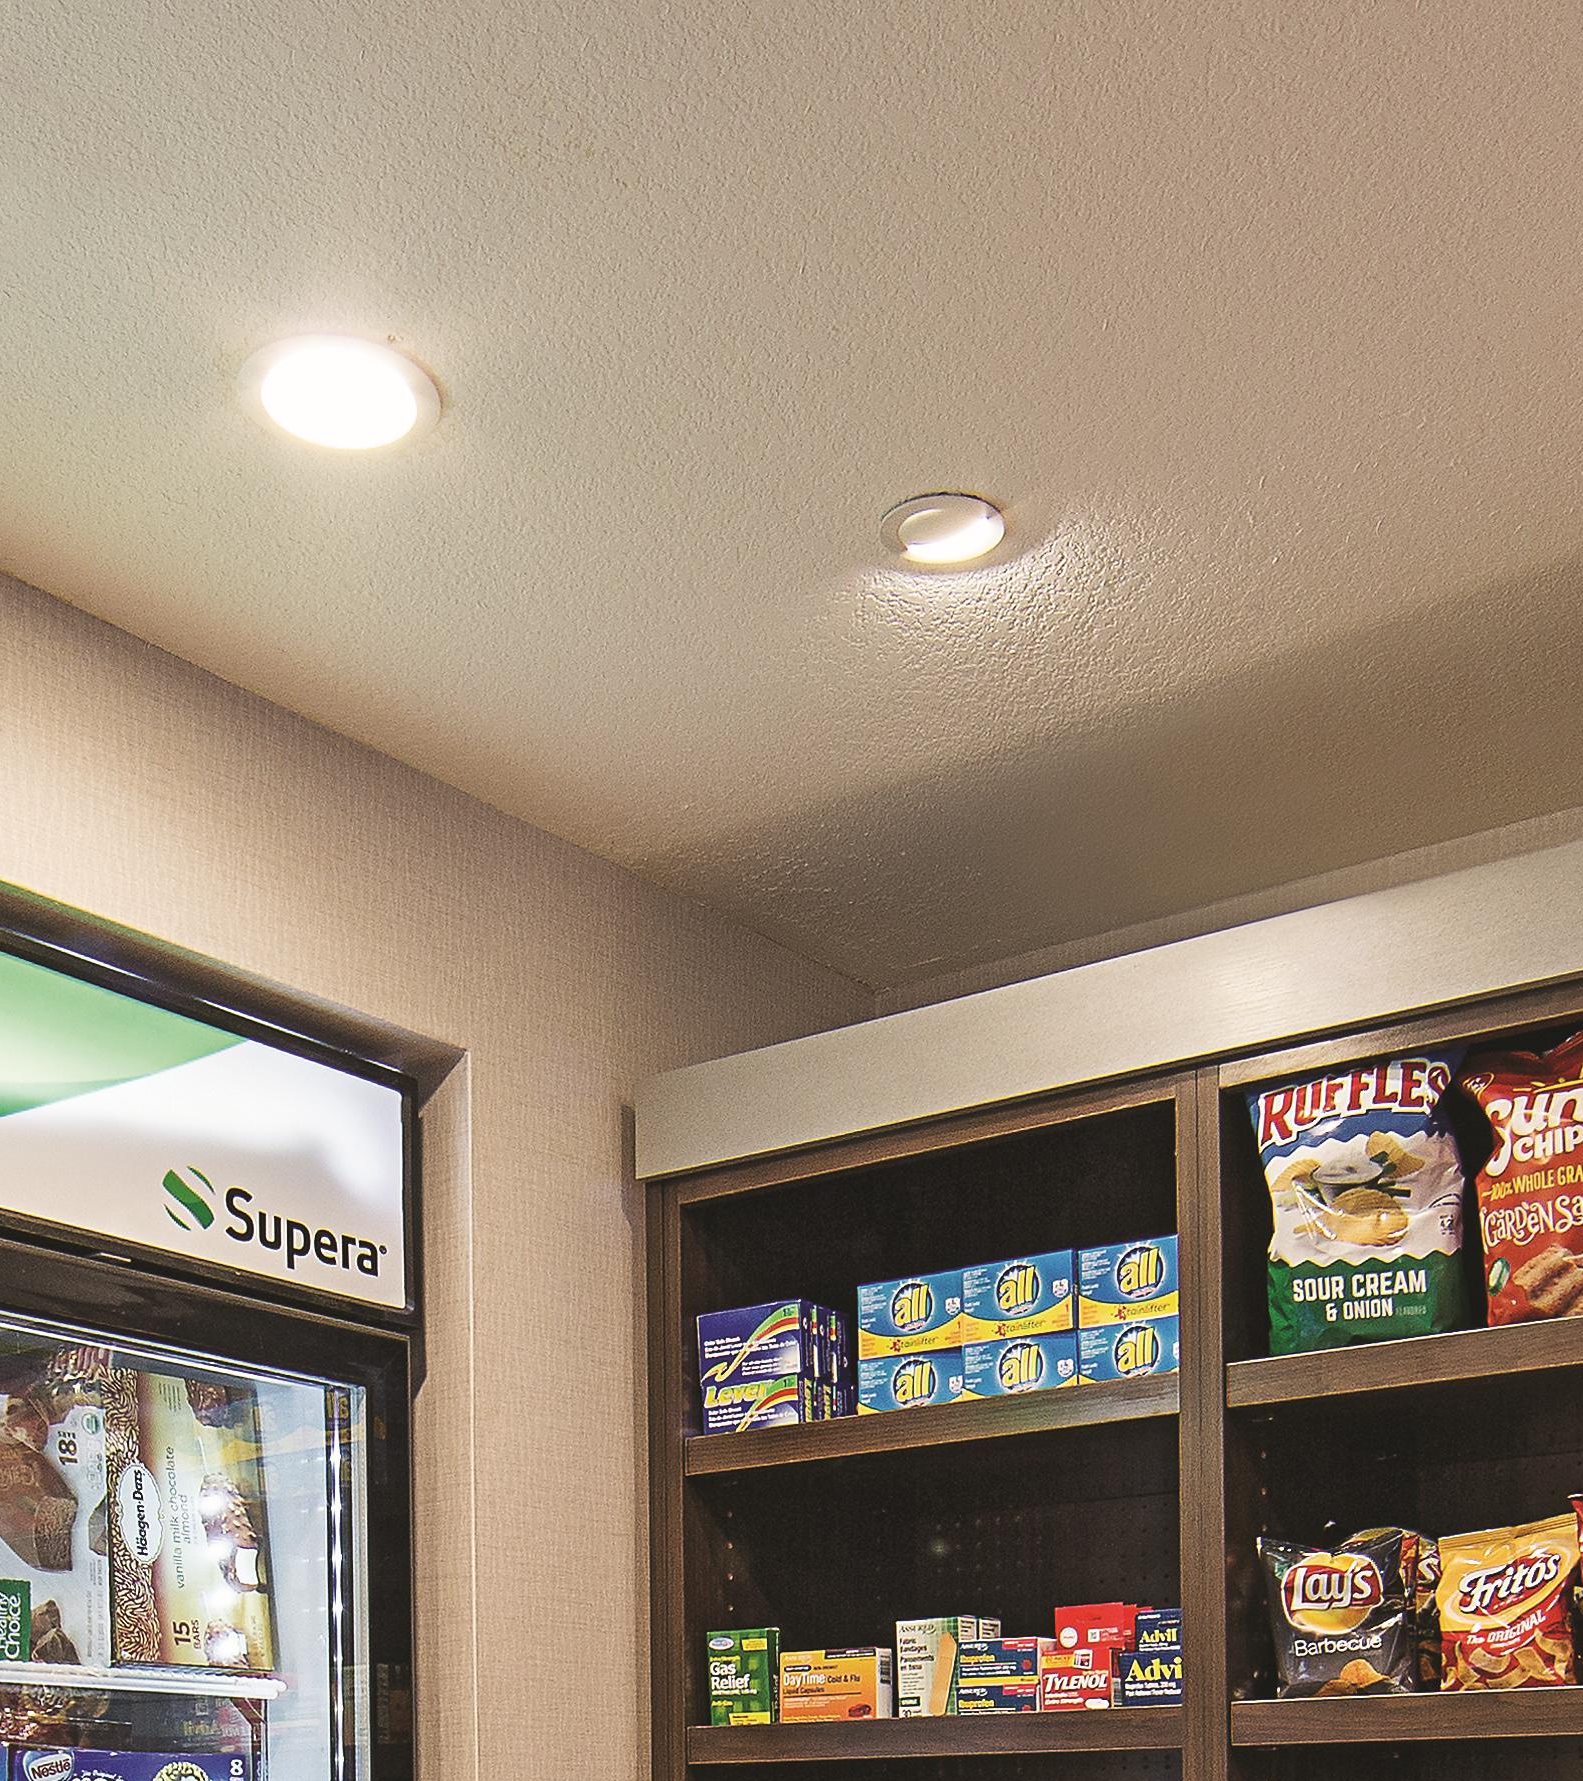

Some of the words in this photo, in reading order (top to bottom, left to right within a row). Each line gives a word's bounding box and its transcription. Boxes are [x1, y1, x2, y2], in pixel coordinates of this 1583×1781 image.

[1512, 1171, 1555, 1192] WHOLE
[225, 1187, 379, 1278] Supera
[1120, 1247, 1159, 1291] all
[998, 1265, 1036, 1310] all
[1292, 1278, 1345, 1302] SOUR
[1350, 1270, 1427, 1297] CREAM
[895, 1283, 929, 1327] all
[1325, 1302, 1338, 1321] &
[1344, 1297, 1393, 1320] ONION
[1117, 1326, 1155, 1369] all
[1002, 1344, 1040, 1387] all
[896, 1361, 931, 1403] all
[1460, 1550, 1560, 1611] Fritos
[173, 1621, 191, 1646] 15
[1141, 1629, 1177, 1643] Advil
[1293, 1633, 1382, 1656] Barbecue
[710, 1662, 736, 1675] Gas
[783, 1673, 826, 1686] DayTime
[711, 1676, 750, 1690] Relief
[1044, 1673, 1107, 1692] TYLENOL
[230, 1759, 243, 1776] 8
